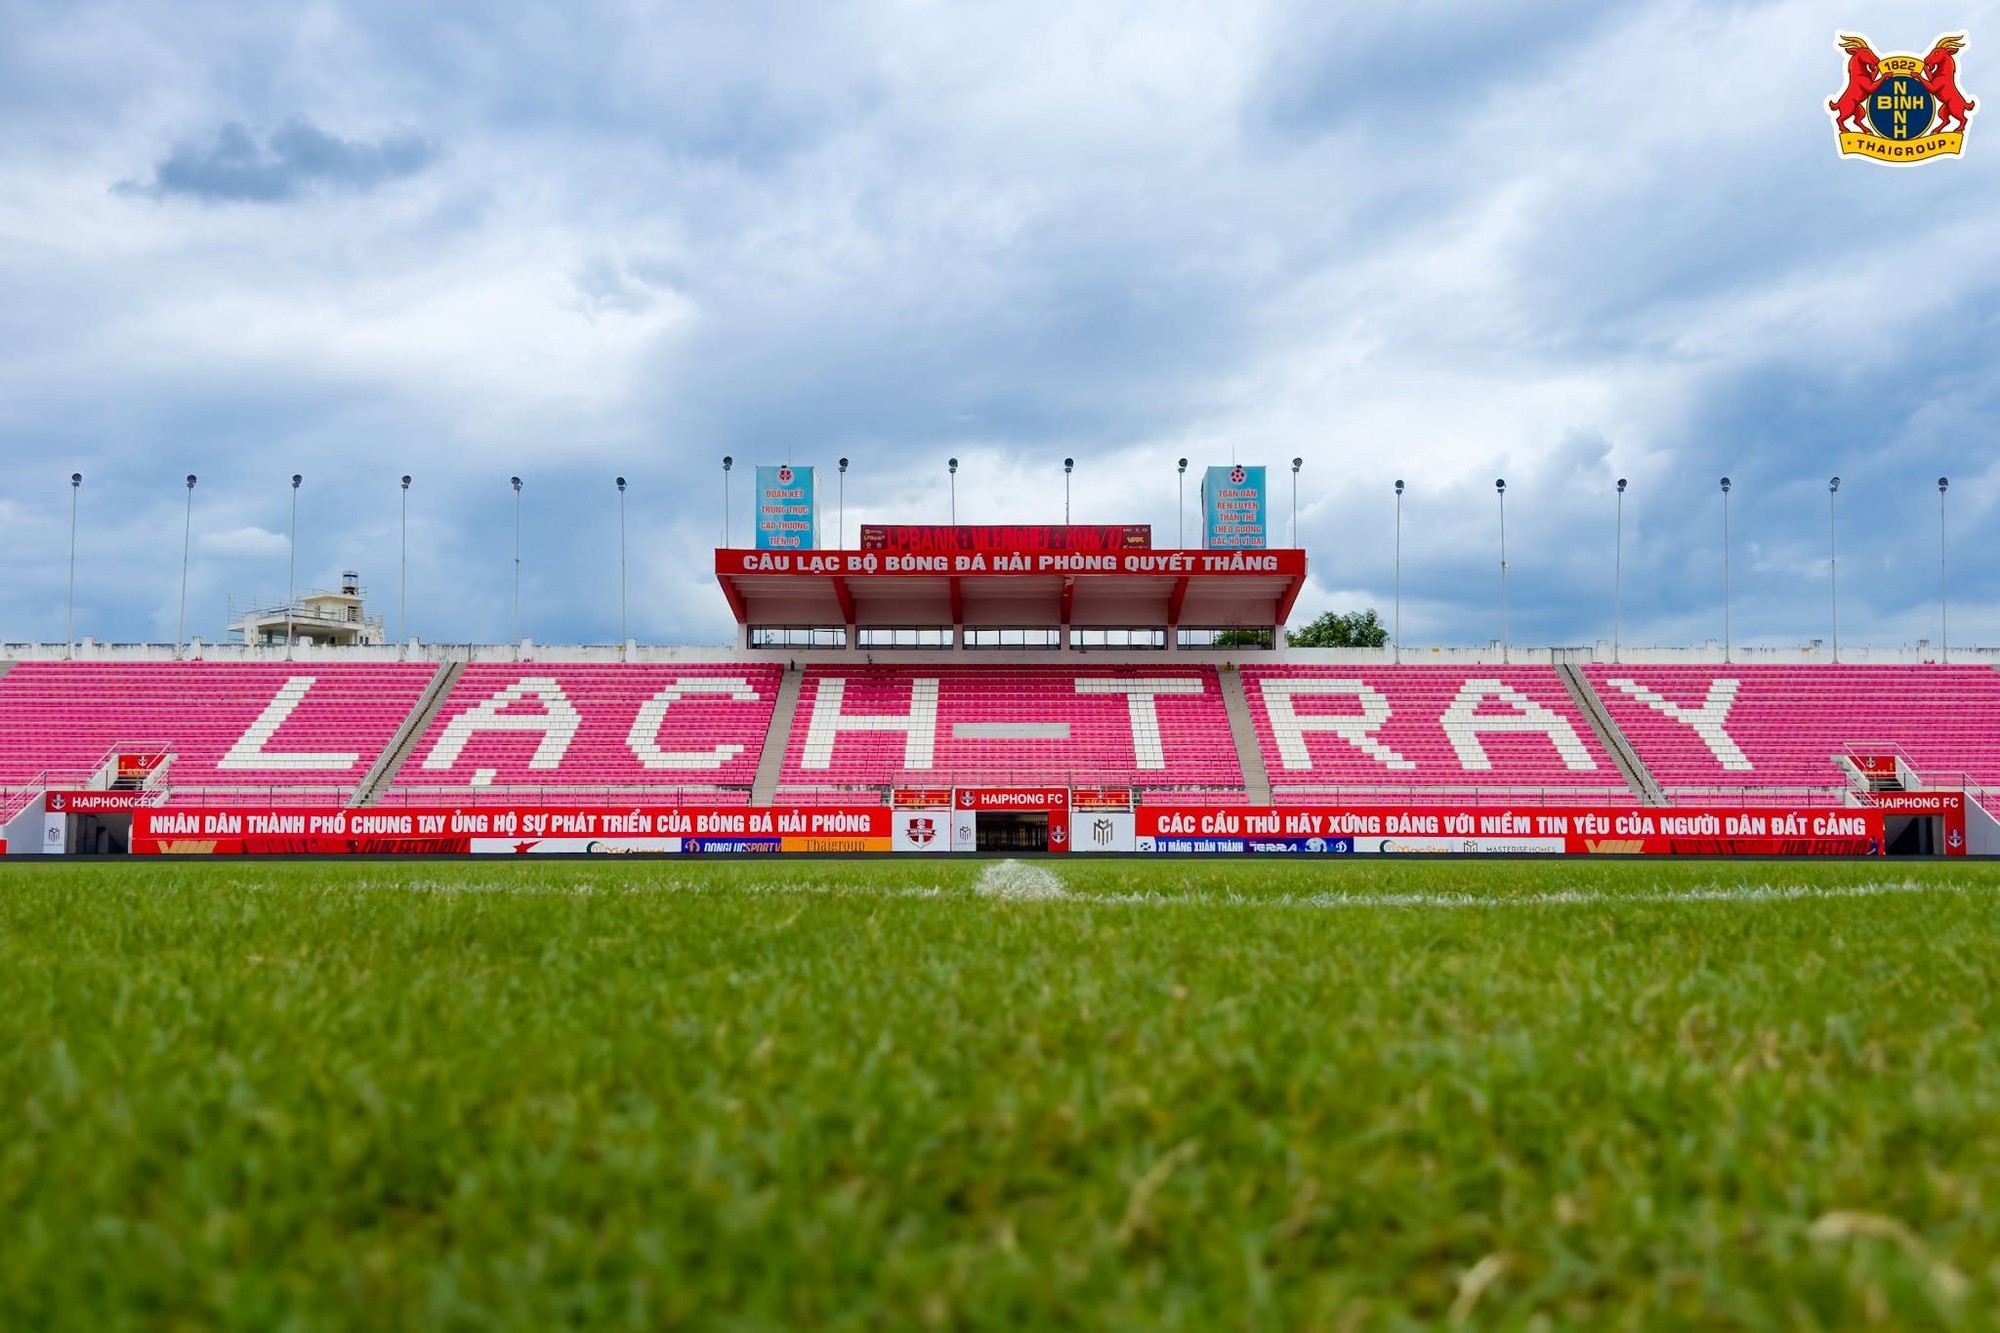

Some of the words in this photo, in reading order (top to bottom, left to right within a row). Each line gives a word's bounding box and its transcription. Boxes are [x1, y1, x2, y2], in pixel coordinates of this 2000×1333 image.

[743, 553, 790, 570] CÂU
[797, 556, 840, 574] LẠC
[847, 553, 878, 574] BỘ
[886, 553, 948, 571] BÓNG
[955, 553, 986, 571] ĐÁ
[993, 551, 1031, 570] HẢI
[1039, 552, 1117, 570] PHÒNG
[1124, 551, 1196, 571] QUYẾT
[1202, 551, 1278, 571] THẮNG
[981, 794, 1045, 805] HAIPHONG
[1047, 794, 1063, 804] FC
[1943, 797, 1959, 808] FC
[150, 812, 200, 834] NHÂN
[205, 812, 241, 834] DÂN
[247, 812, 304, 834] THÀNH
[309, 810, 347, 834] PHỐ
[351, 815, 412, 834] CHUNG
[417, 815, 447, 834] TAY
[451, 809, 488, 833] ỦNG
[493, 811, 517, 836] HỘ
[522, 813, 549, 836] SỰ
[551, 811, 597, 833] PHÁT
[601, 808, 652, 833] TRIỂN
[656, 809, 692, 833] CỦA
[696, 811, 745, 833] BÓNG
[749, 811, 773, 832] ĐÁ
[778, 809, 806, 832] HẢI
[811, 810, 871, 832] PHÒNG
[1158, 812, 1196, 833] CÁC
[1201, 810, 1239, 833] CẦU
[1244, 810, 1281, 833] THỦ
[1286, 812, 1322, 833] HÃY
[1328, 812, 1381, 834] XỨNG
[1386, 812, 1439, 834] ĐÁNG
[1443, 812, 1475, 834] VỚI
[1481, 811, 1531, 834] NIỀM
[1536, 816, 1568, 834] TIN
[1573, 813, 1610, 835] YÊU
[1615, 811, 1655, 835] CỦA
[1660, 813, 1720, 835] NGƯỜI
[1725, 813, 1766, 835] DÂN
[1771, 811, 1808, 836] ĐẤT
[1813, 812, 1865, 836] CẢNG
[1158, 841, 1166, 852] XI
